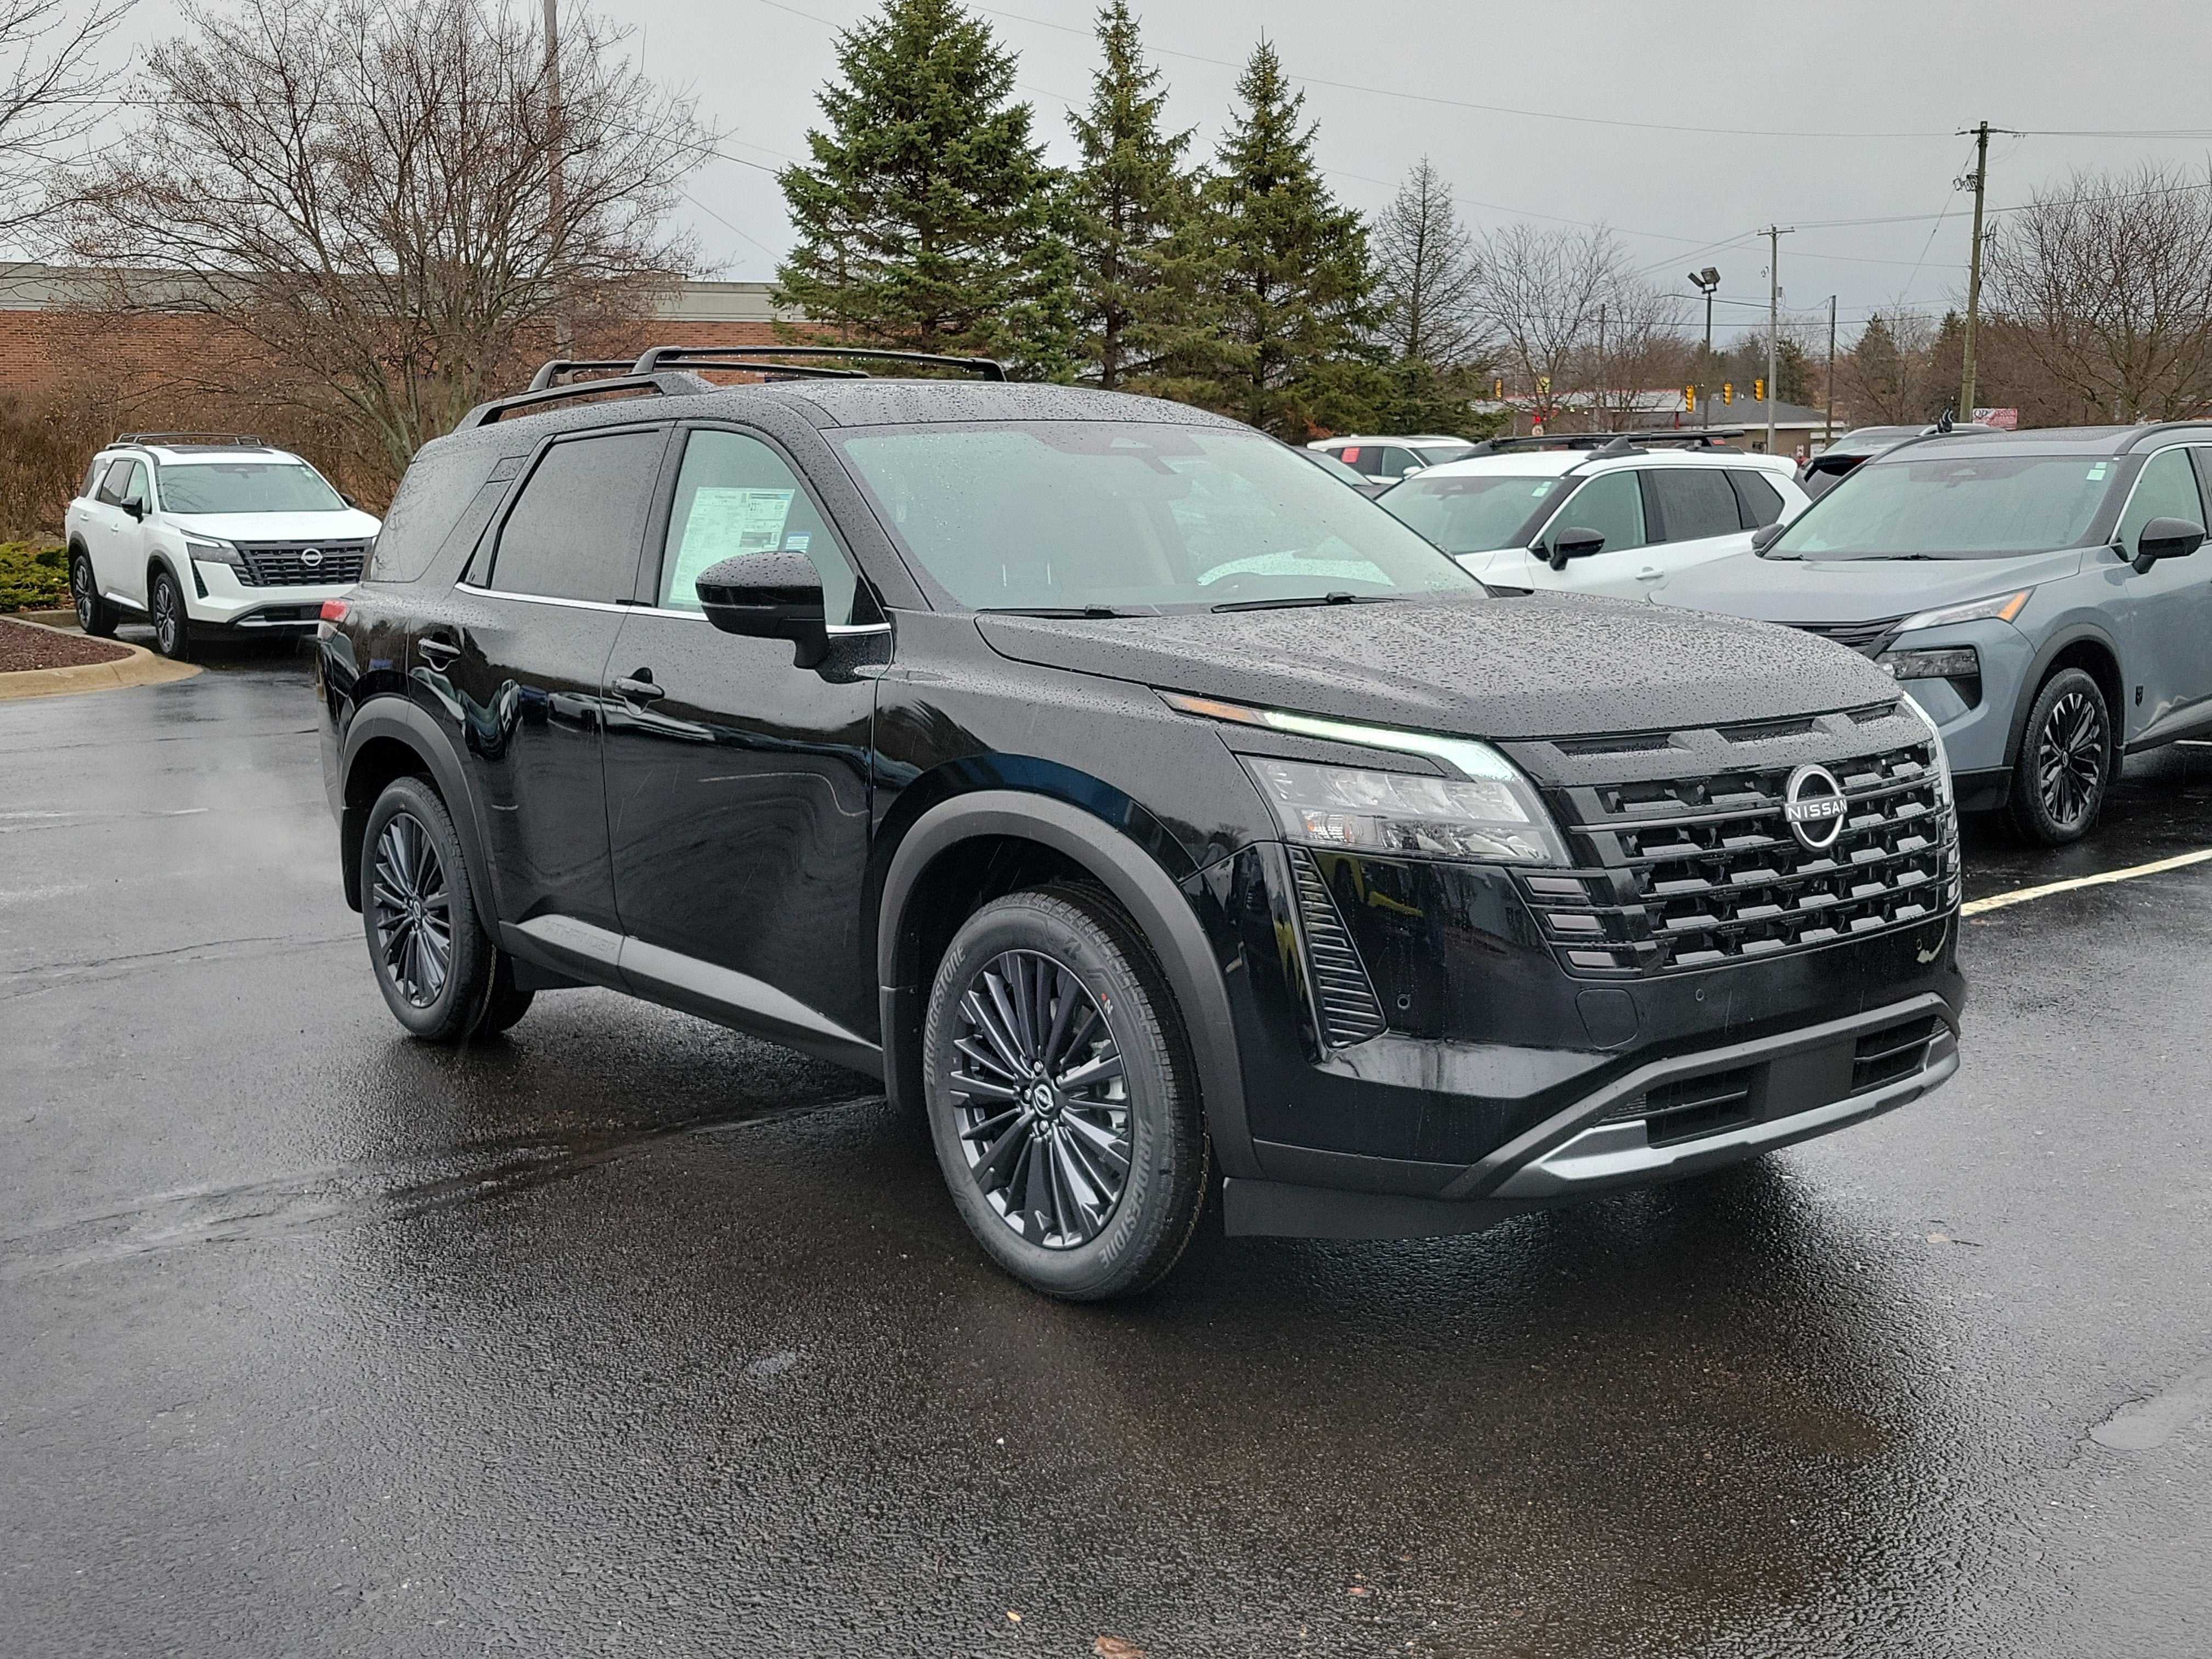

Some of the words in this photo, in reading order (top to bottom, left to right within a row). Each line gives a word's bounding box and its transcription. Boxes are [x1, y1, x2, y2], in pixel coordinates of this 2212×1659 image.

[1787, 798, 1848, 820] NISSAN
[925, 945, 966, 1087] BRIDGESTONE
[1099, 1118, 1154, 1269] BRIDGESTONE
